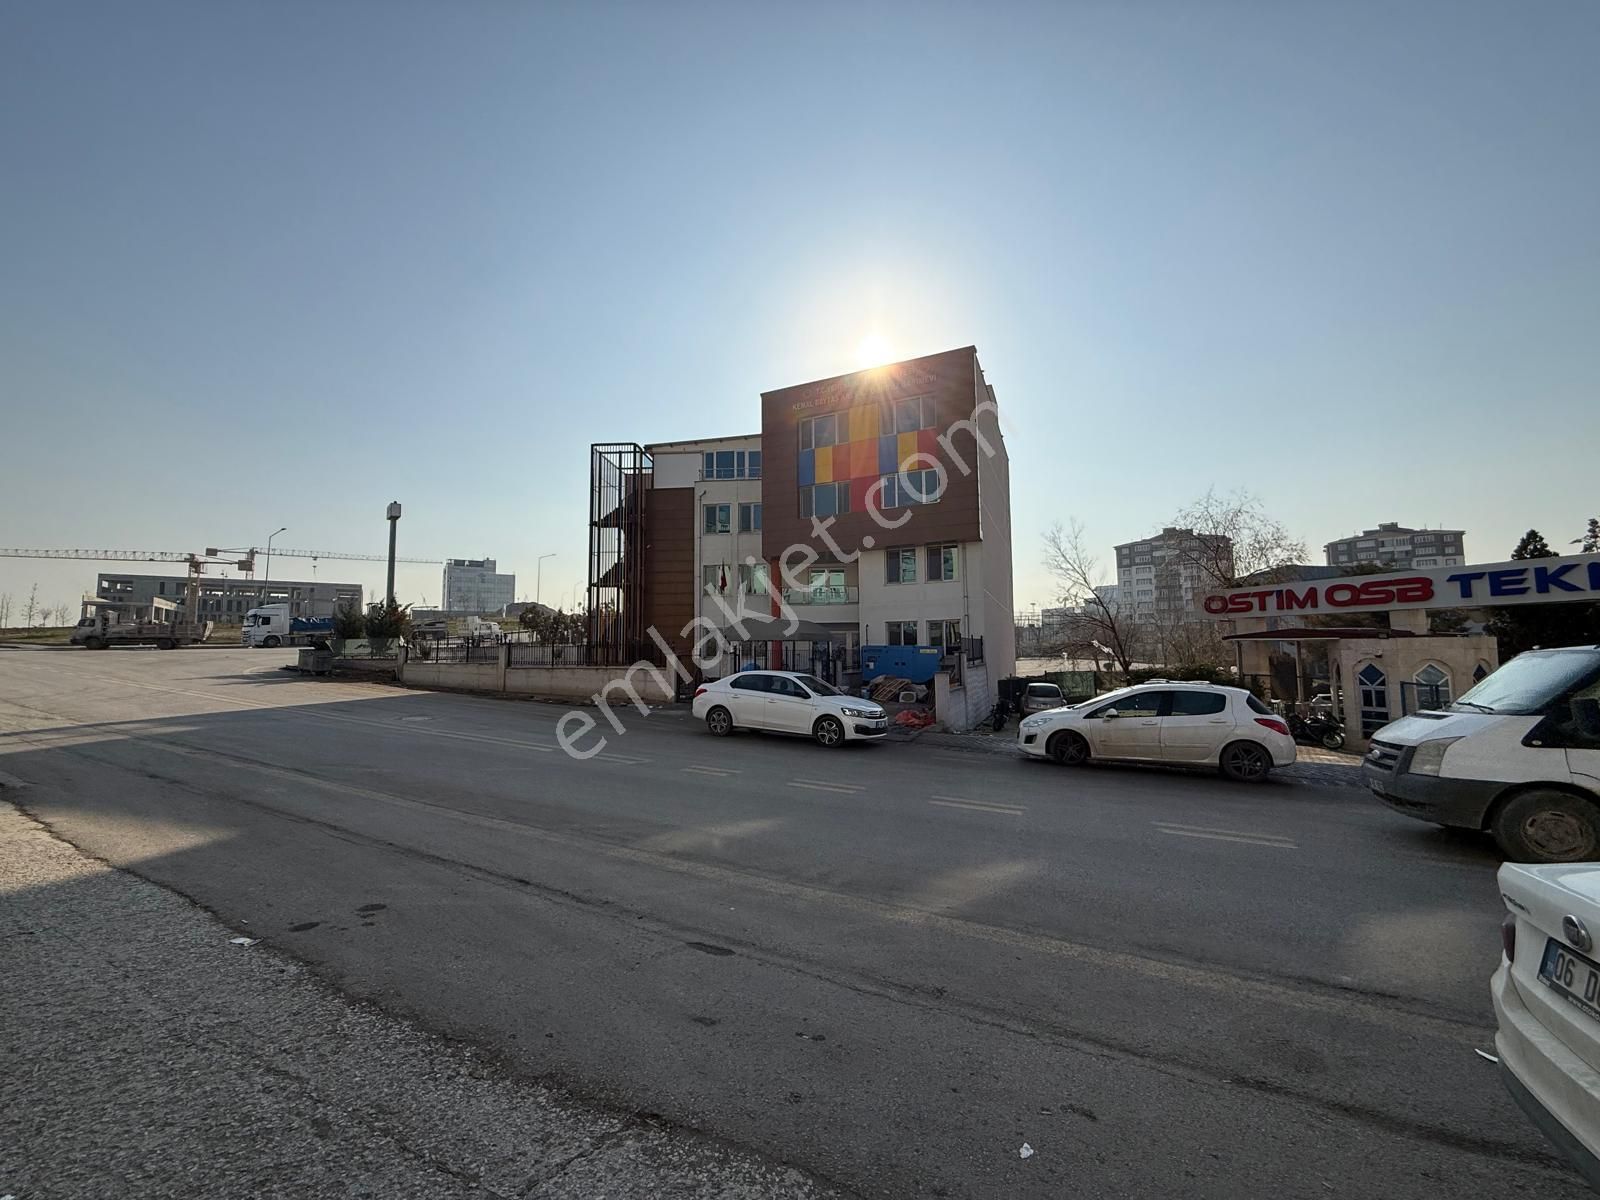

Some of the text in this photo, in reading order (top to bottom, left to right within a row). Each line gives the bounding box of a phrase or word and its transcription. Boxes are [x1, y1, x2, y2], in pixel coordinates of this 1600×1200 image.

[1325, 577, 1434, 607] OSB
[1555, 952, 1576, 988] 06
[1584, 969, 1600, 1009] D
